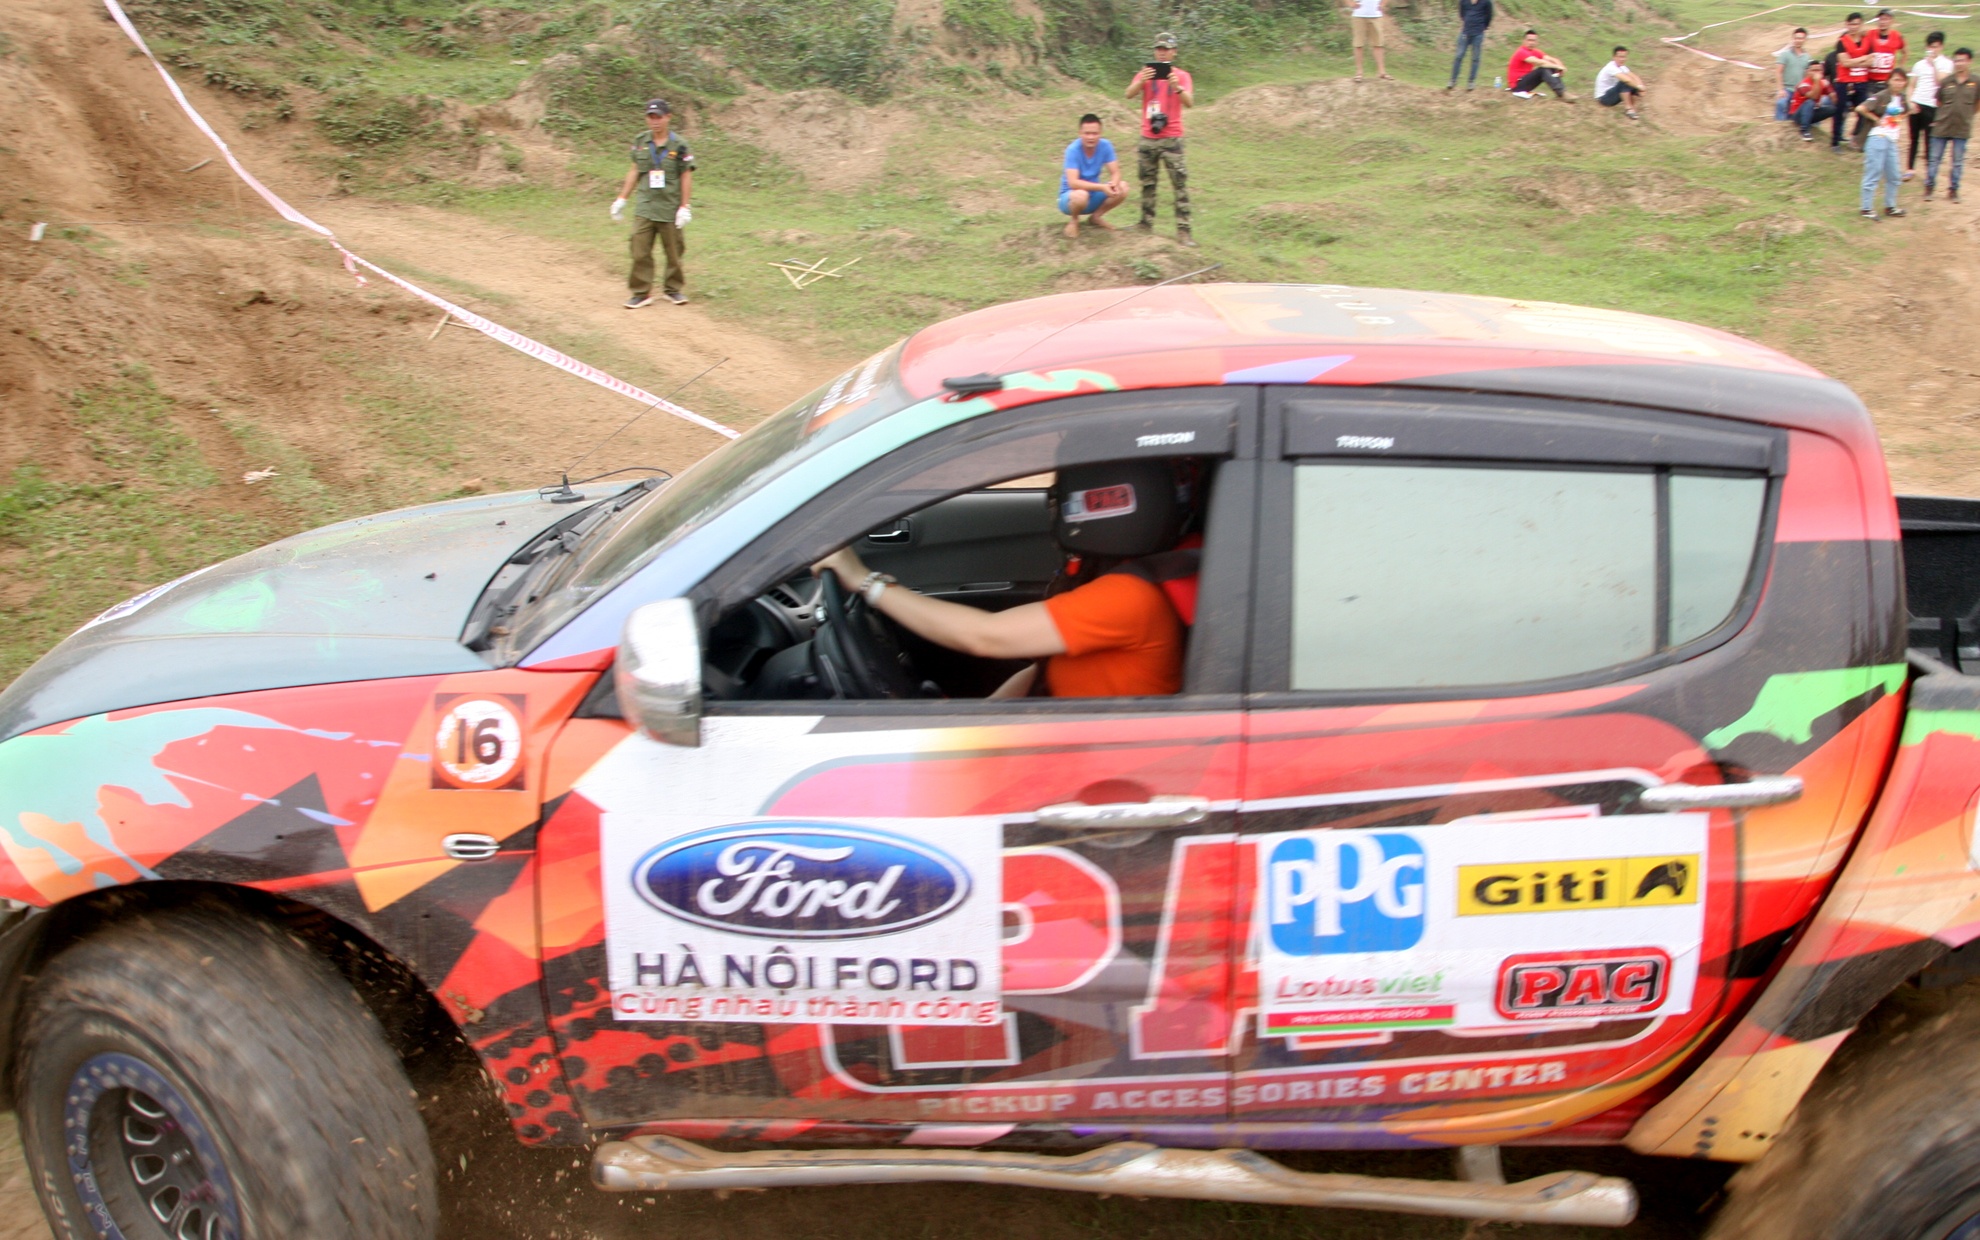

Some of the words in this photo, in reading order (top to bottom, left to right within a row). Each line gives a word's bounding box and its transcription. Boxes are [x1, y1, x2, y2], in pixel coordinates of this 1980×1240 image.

[457, 718, 503, 766] 16
[697, 840, 906, 920] Ford
[1271, 830, 1424, 938] PPG
[1472, 868, 1611, 907] Giti
[632, 943, 707, 990] HÀ
[723, 945, 816, 996] NỘI
[834, 956, 980, 992] FORD
[1512, 960, 1654, 1009] PAC
[915, 1092, 1077, 1118] PICKUP
[1090, 1074, 1387, 1112] ACCESSORIES
[1400, 1060, 1568, 1095] CENTER
